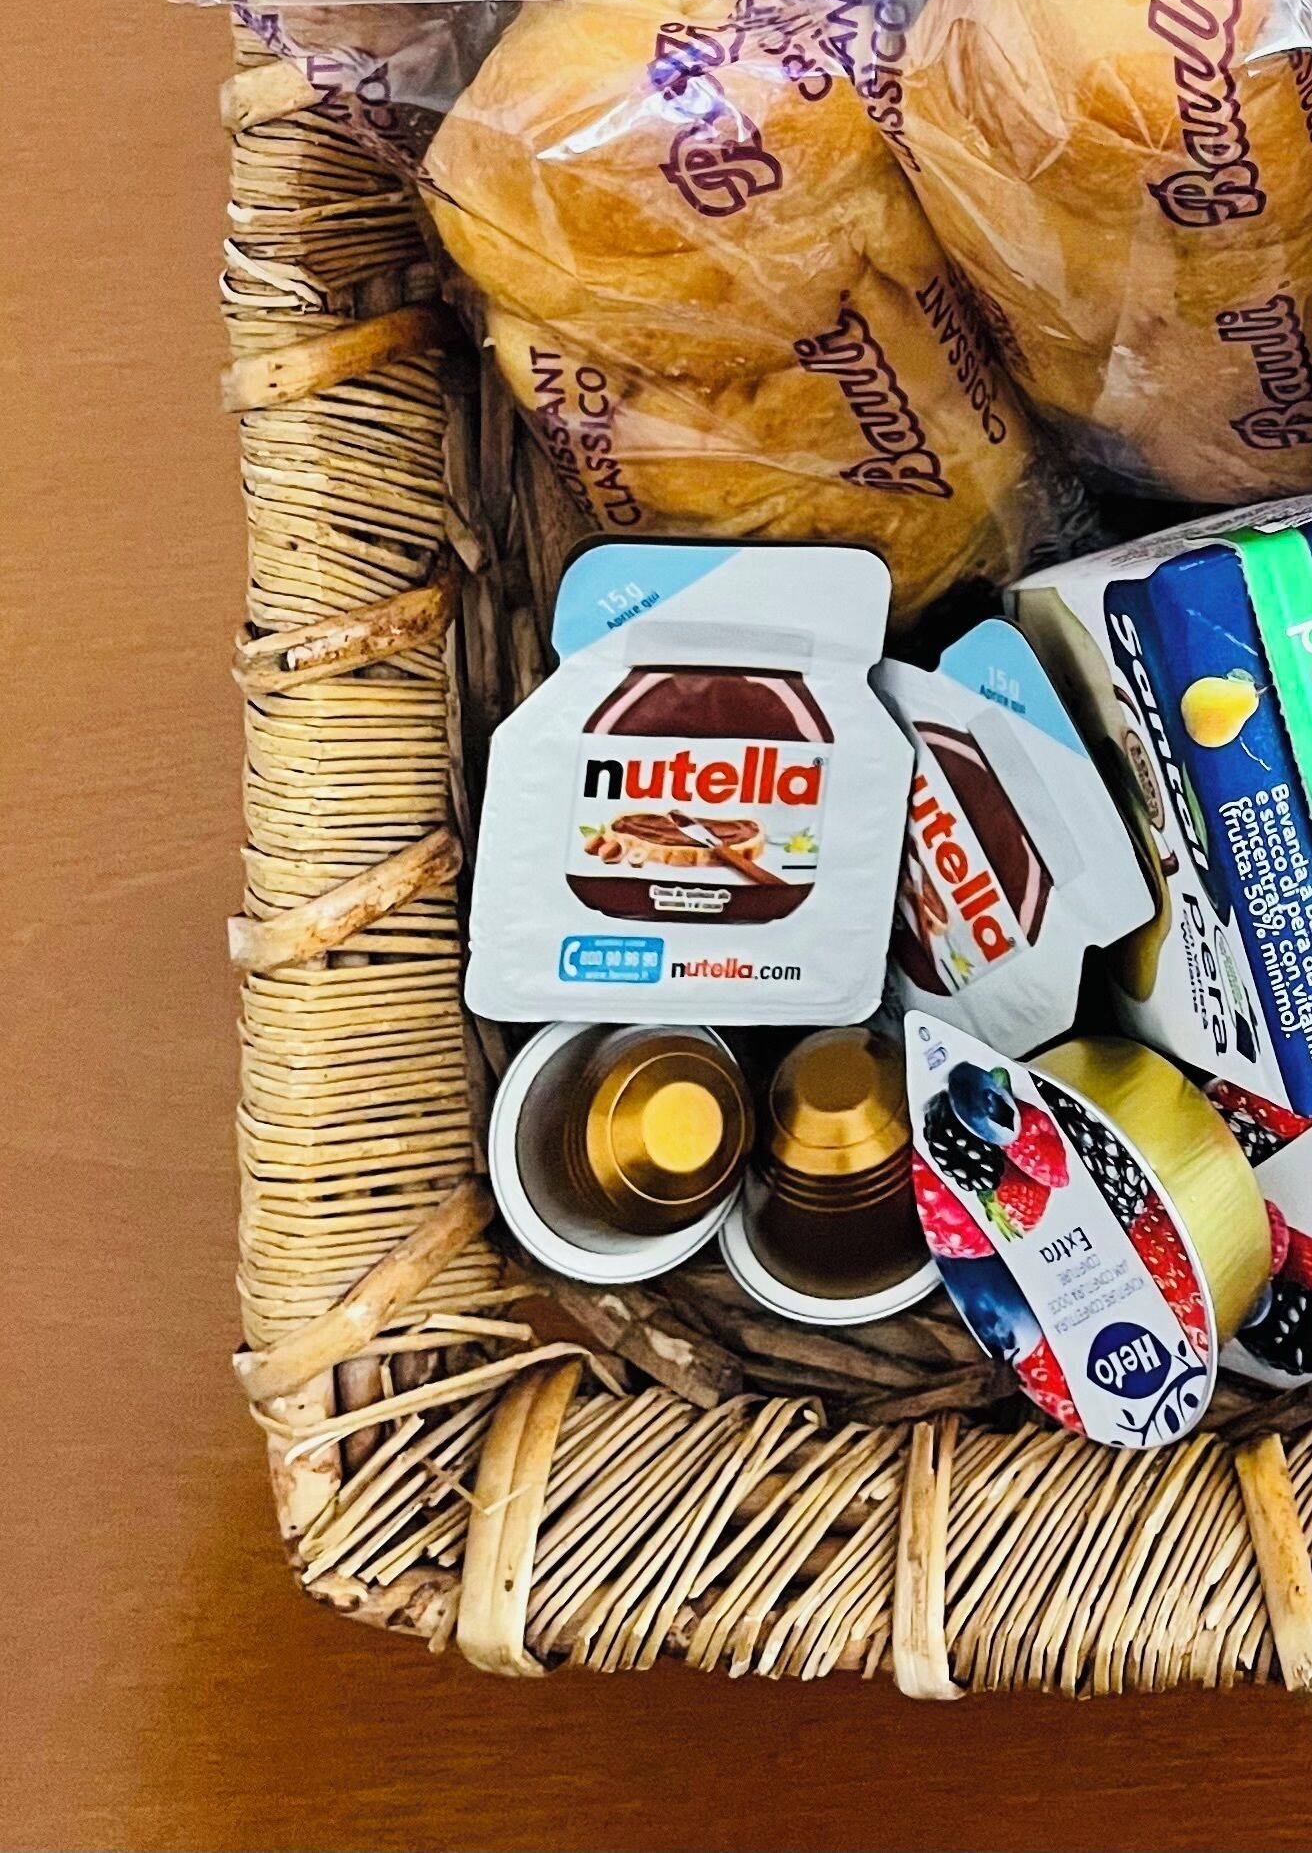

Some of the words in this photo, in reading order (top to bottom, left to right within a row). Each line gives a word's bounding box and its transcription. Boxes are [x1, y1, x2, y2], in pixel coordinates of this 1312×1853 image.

[915, 275, 1007, 445] CROISSANT
[575, 366, 642, 526] CLASSICO
[793, 307, 954, 500] Bauli
[597, 589, 628, 615] 15
[583, 746, 823, 806] nutella
[1110, 613, 1208, 871] Santal
[1255, 790, 1270, 806] e
[1259, 803, 1288, 873] succo
[1271, 783, 1310, 883] Bevanda
[909, 774, 1013, 963] utella
[1238, 796, 1287, 937] concentrato,
[1278, 939, 1302, 980] con
[1278, 874, 1301, 897] di
[1218, 800, 1253, 881] (frutta:
[1243, 884, 1275, 941] 50%
[1260, 942, 1303, 1039] minimo).
[1283, 901, 1312, 957] pera
[671, 957, 802, 981] nutella.com
[1182, 892, 1228, 1057] pera
[1039, 1227, 1093, 1264] Extra
[1095, 1334, 1161, 1389] Hero
